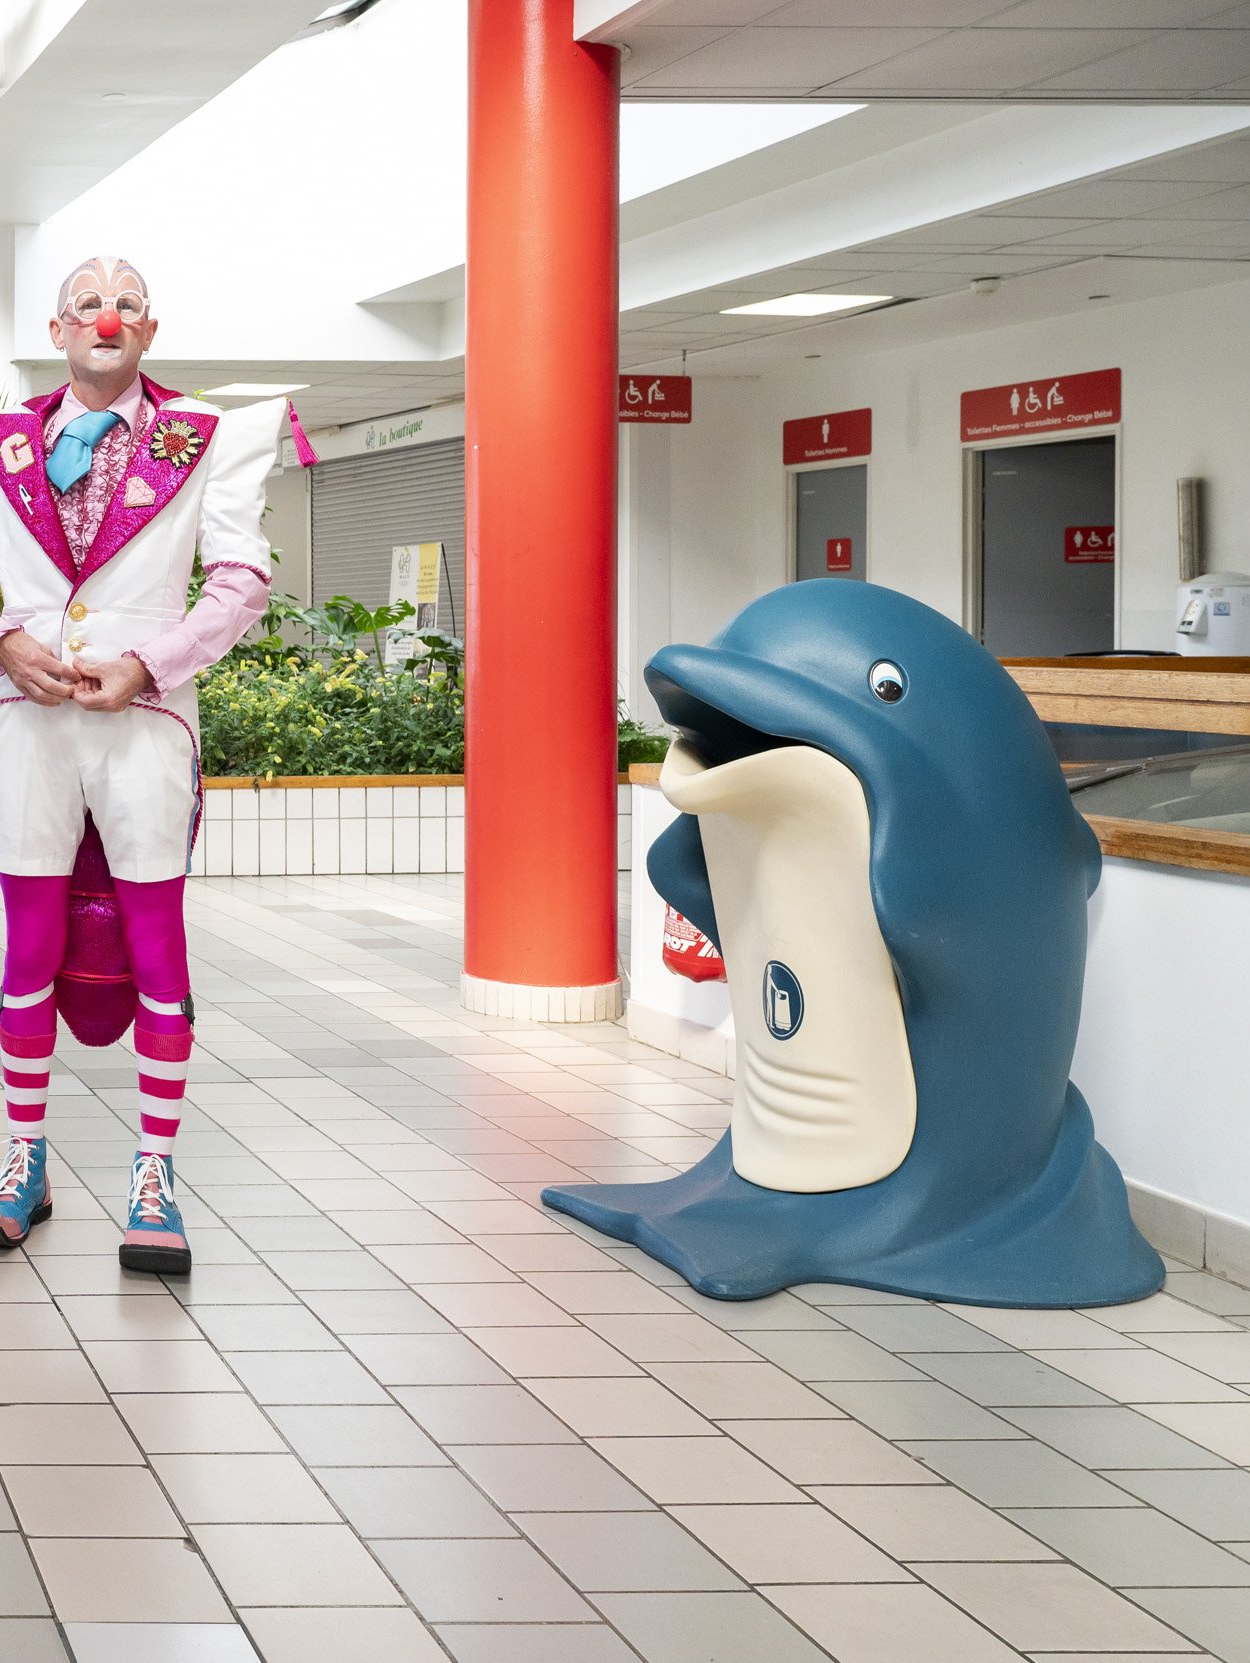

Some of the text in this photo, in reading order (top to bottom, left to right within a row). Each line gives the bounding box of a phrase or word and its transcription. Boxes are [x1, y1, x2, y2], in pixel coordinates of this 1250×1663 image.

[644, 410, 670, 420] Change
[670, 410, 689, 418] Bébé
[966, 427, 992, 436] Toilettes
[992, 423, 1019, 433] Femmes
[1024, 416, 1062, 428] accessibles
[1066, 413, 1093, 423] Change
[1093, 409, 1113, 419] Bébé
[379, 419, 423, 448] la boutique
[0, 431, 35, 475] G
